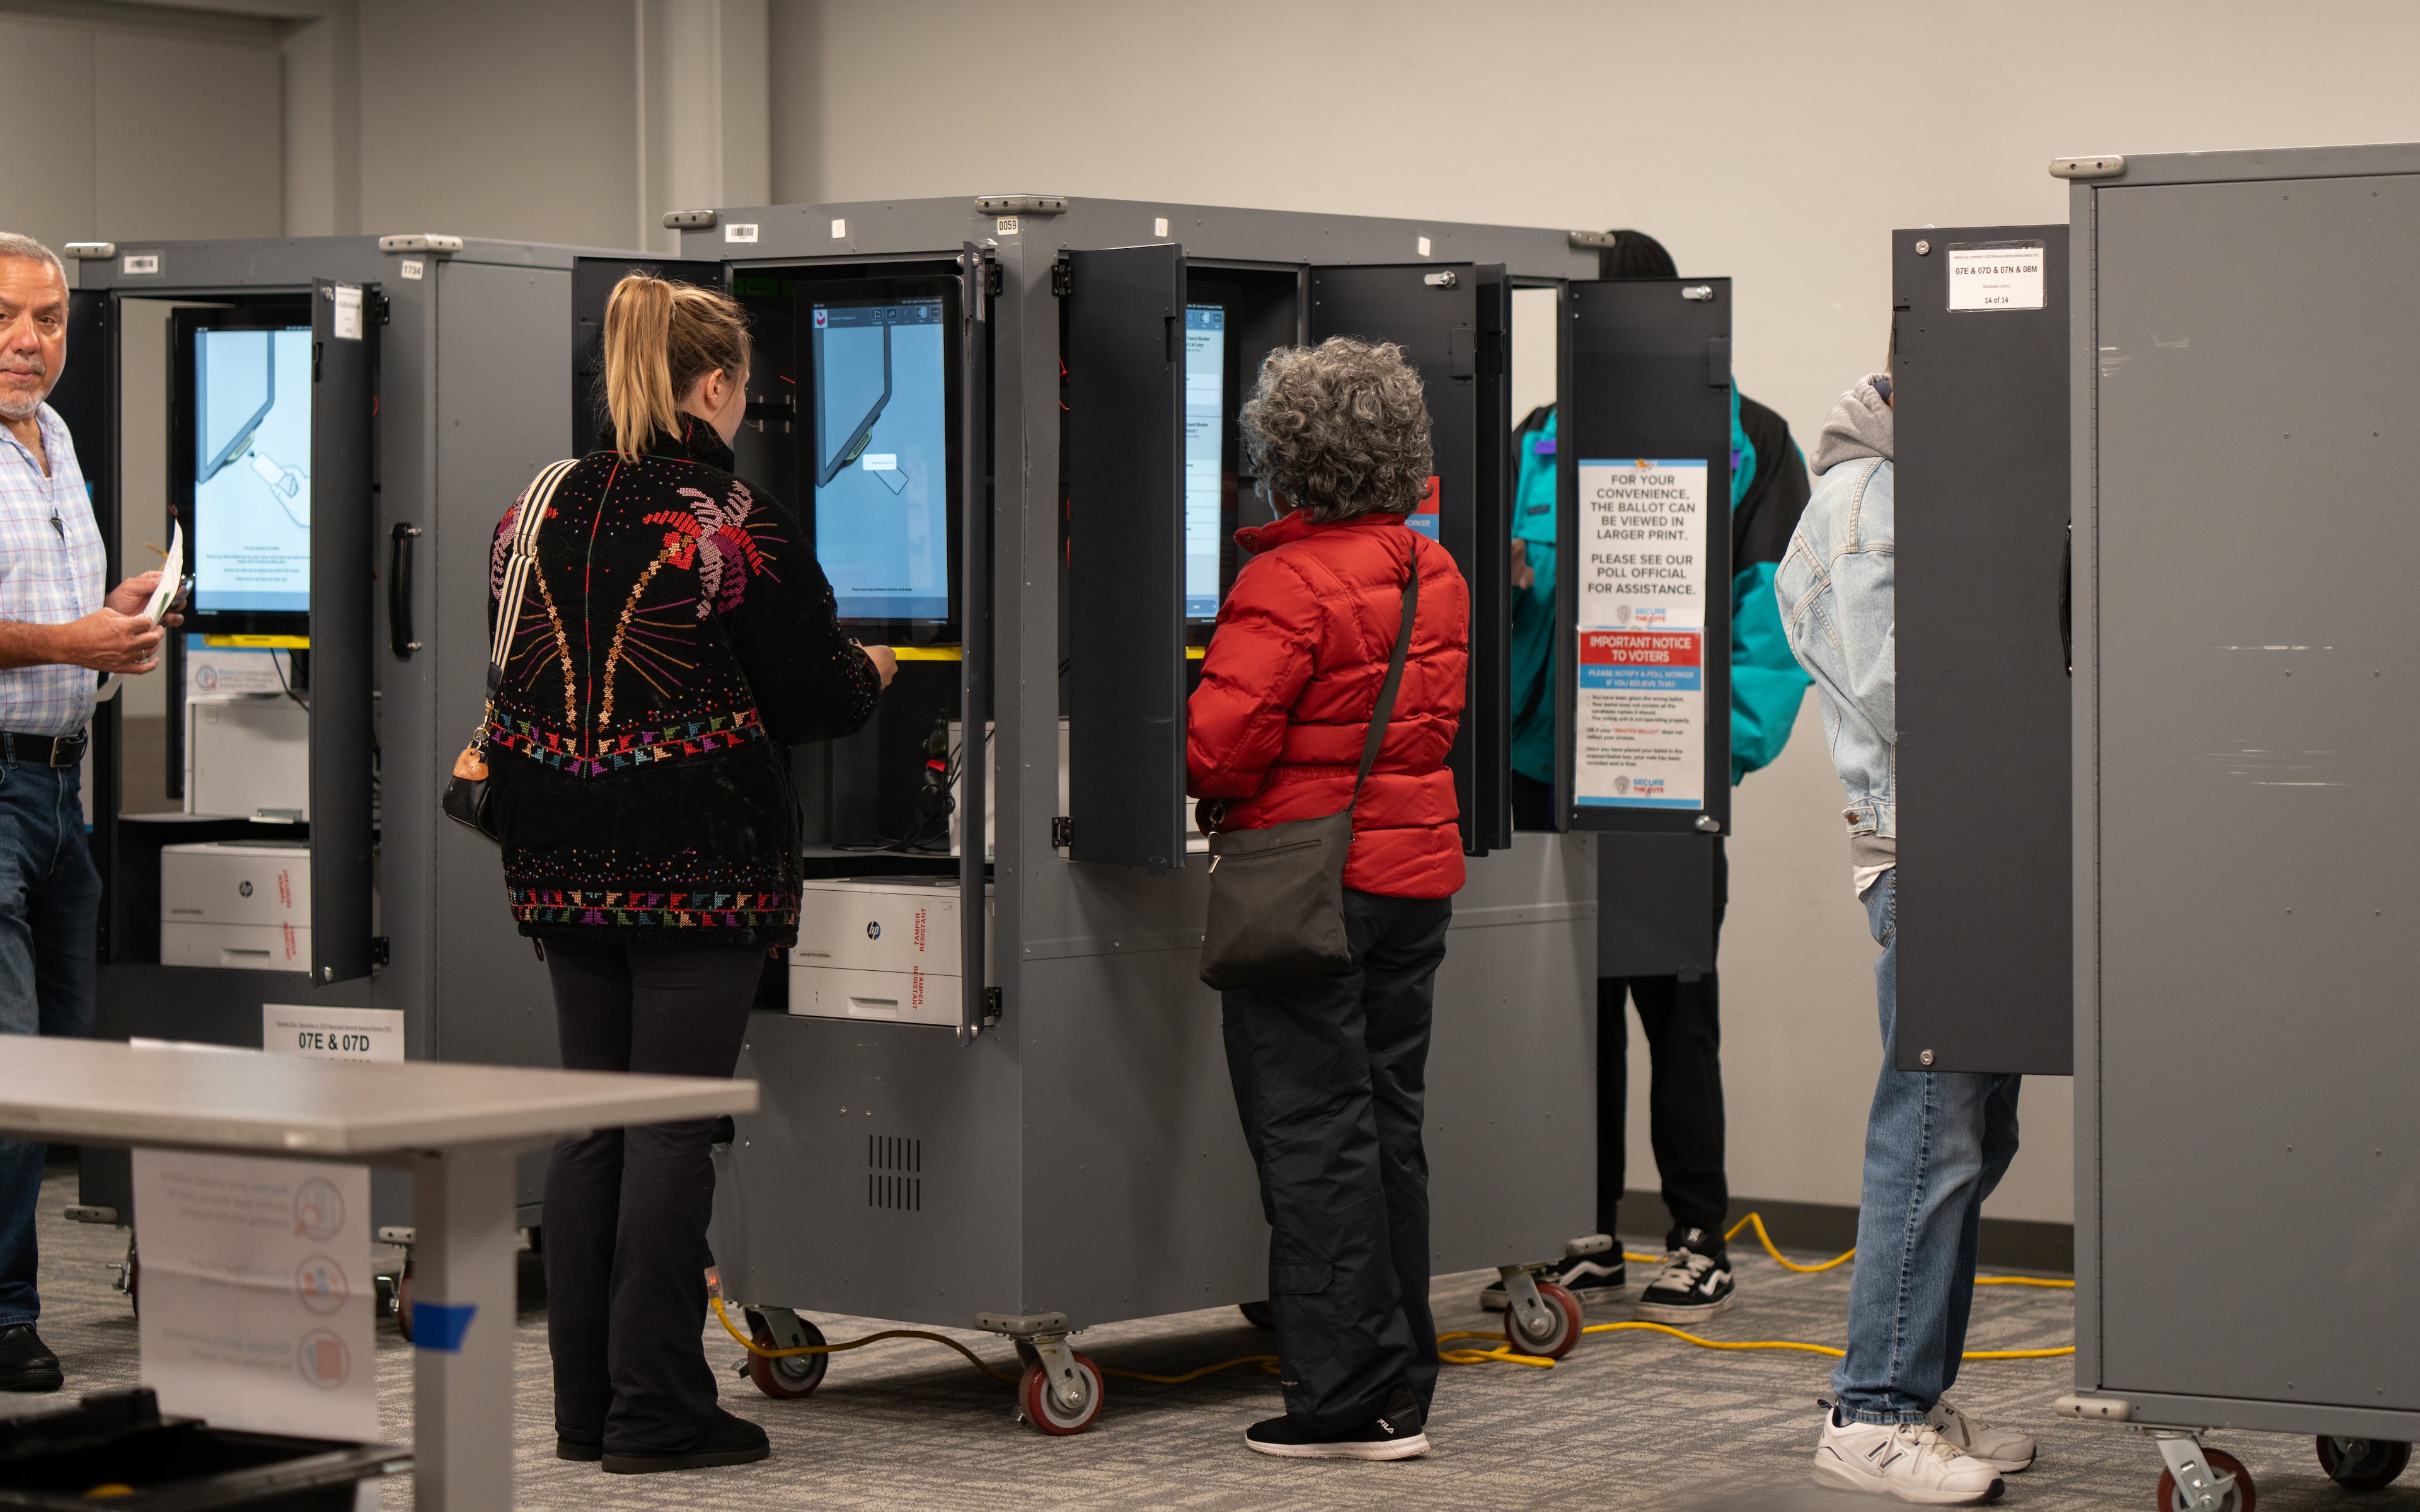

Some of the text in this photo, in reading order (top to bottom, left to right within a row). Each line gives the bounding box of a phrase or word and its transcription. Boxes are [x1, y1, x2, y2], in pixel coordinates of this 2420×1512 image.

[1000, 220, 1017, 231] 0059
[405, 265, 420, 275] 1734
[1611, 475, 1675, 485] FOR YOUR
[1597, 488, 1690, 500] CONVENIENCE,
[1591, 502, 1695, 513] THE BALLOT CAN
[1601, 516, 1684, 526] BE VIEWED IN
[1598, 530, 1688, 541] LARGER PRINT.
[1591, 554, 1693, 565] PLEASE SEE OUR
[1598, 568, 1686, 578] POLL OFFICIAL
[1588, 583, 1695, 595] FOR ASSISTANCE.
[1590, 636, 1691, 650] IMPORTANT NOTICE
[1612, 650, 1670, 662] TO VOTERS
[867, 921, 881, 940] hp
[299, 1032, 369, 1051] 07E & 07D
[1376, 1418, 1394, 1434] FILA
